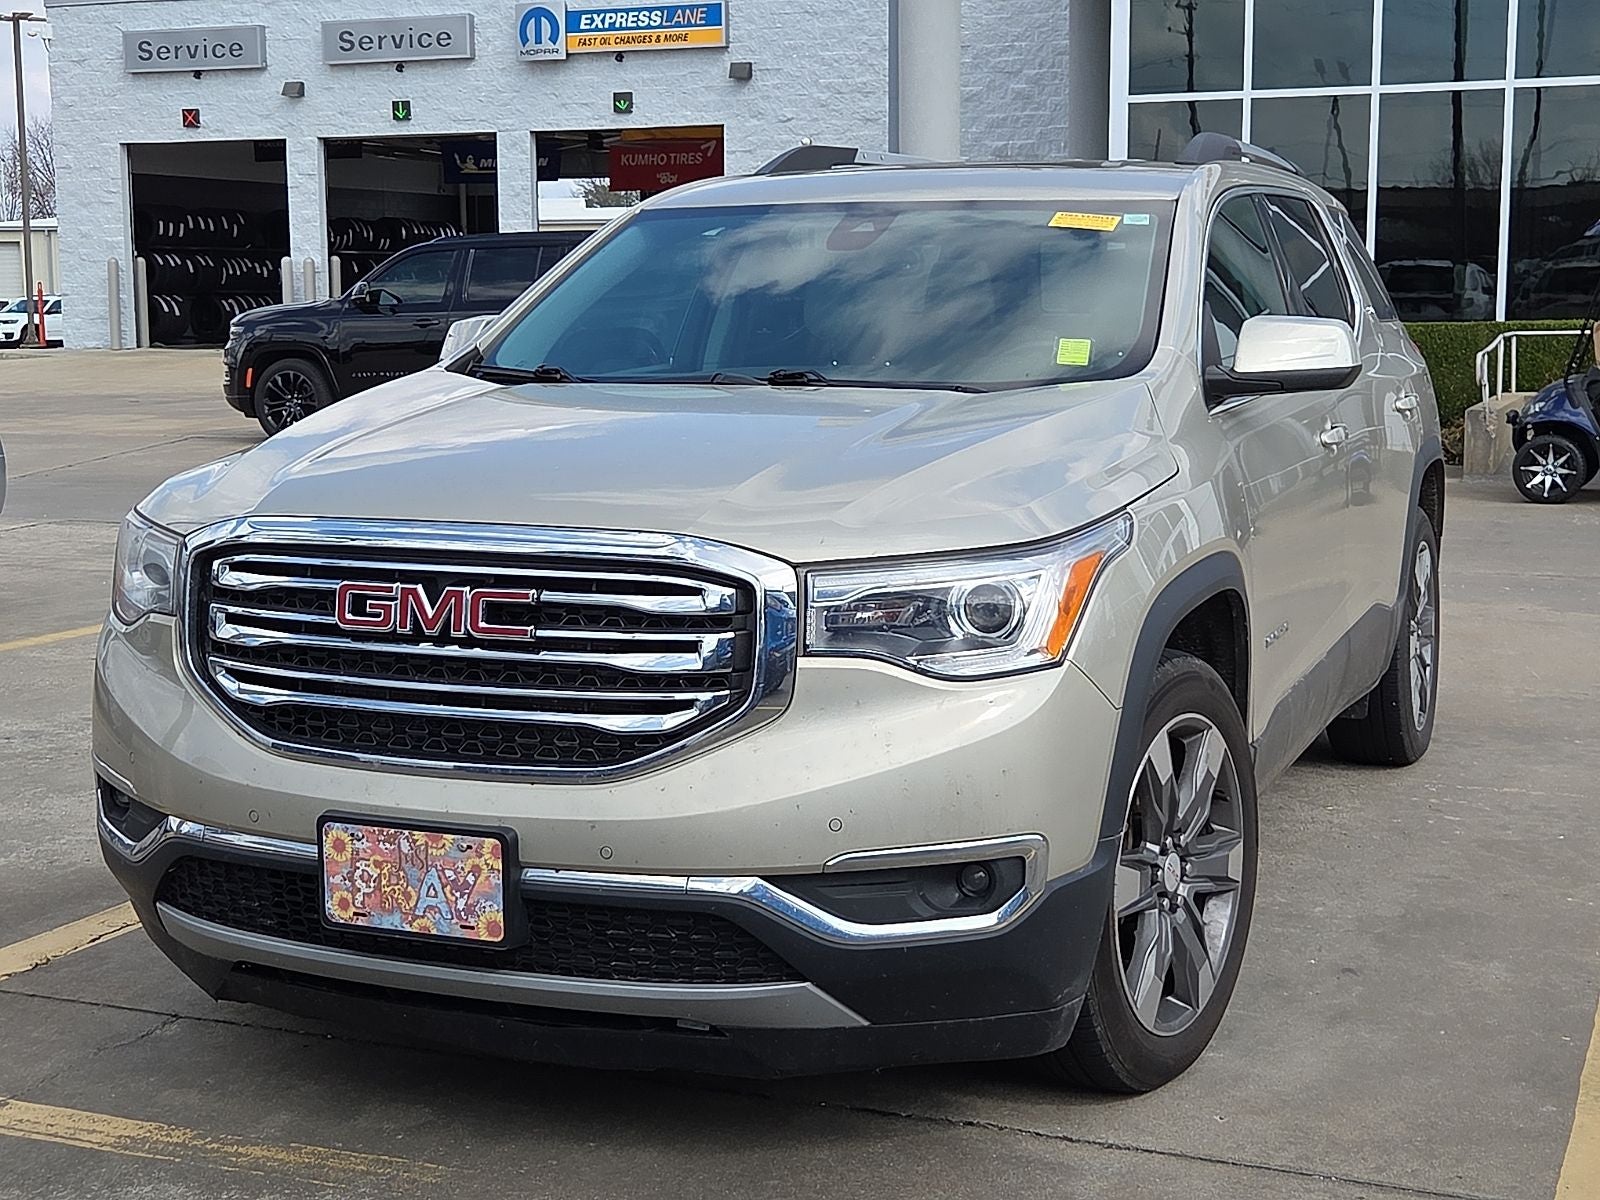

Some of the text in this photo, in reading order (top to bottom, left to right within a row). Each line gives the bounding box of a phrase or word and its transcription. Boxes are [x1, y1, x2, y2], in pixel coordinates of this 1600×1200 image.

[137, 38, 244, 61] Service
[338, 27, 452, 52] Service
[577, 33, 689, 47] FAST OIL CHANGES & MORE
[519, 47, 560, 56] MOPAR
[620, 152, 703, 166] KUMHO TIRES
[336, 581, 537, 641] GMC
[352, 858, 483, 922] PRAY
